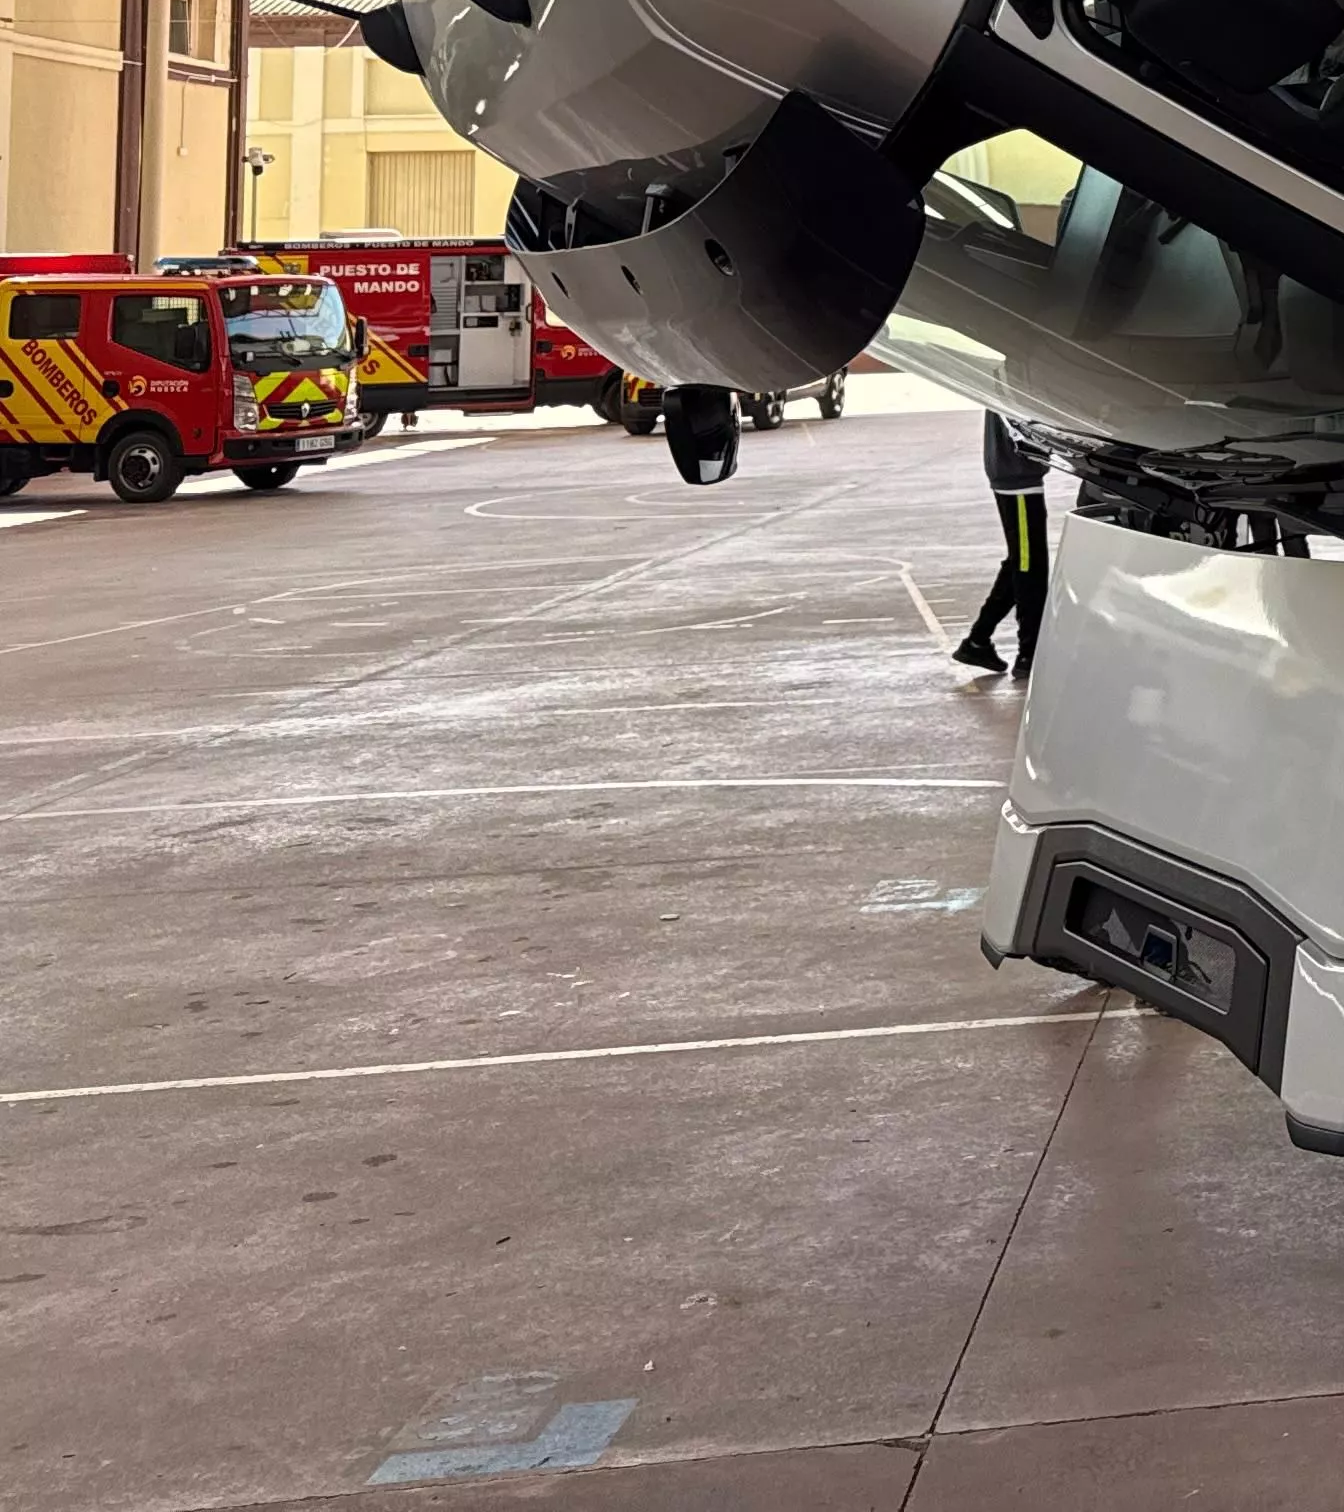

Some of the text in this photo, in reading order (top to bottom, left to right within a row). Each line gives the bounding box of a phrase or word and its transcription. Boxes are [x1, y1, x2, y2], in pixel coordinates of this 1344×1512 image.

[284, 242, 350, 250] BOMBEROS
[432, 240, 474, 248] MANDO
[319, 263, 420, 276] PUESTO DE
[354, 280, 420, 294] MANDO
[21, 339, 97, 425] BOMBEROS
